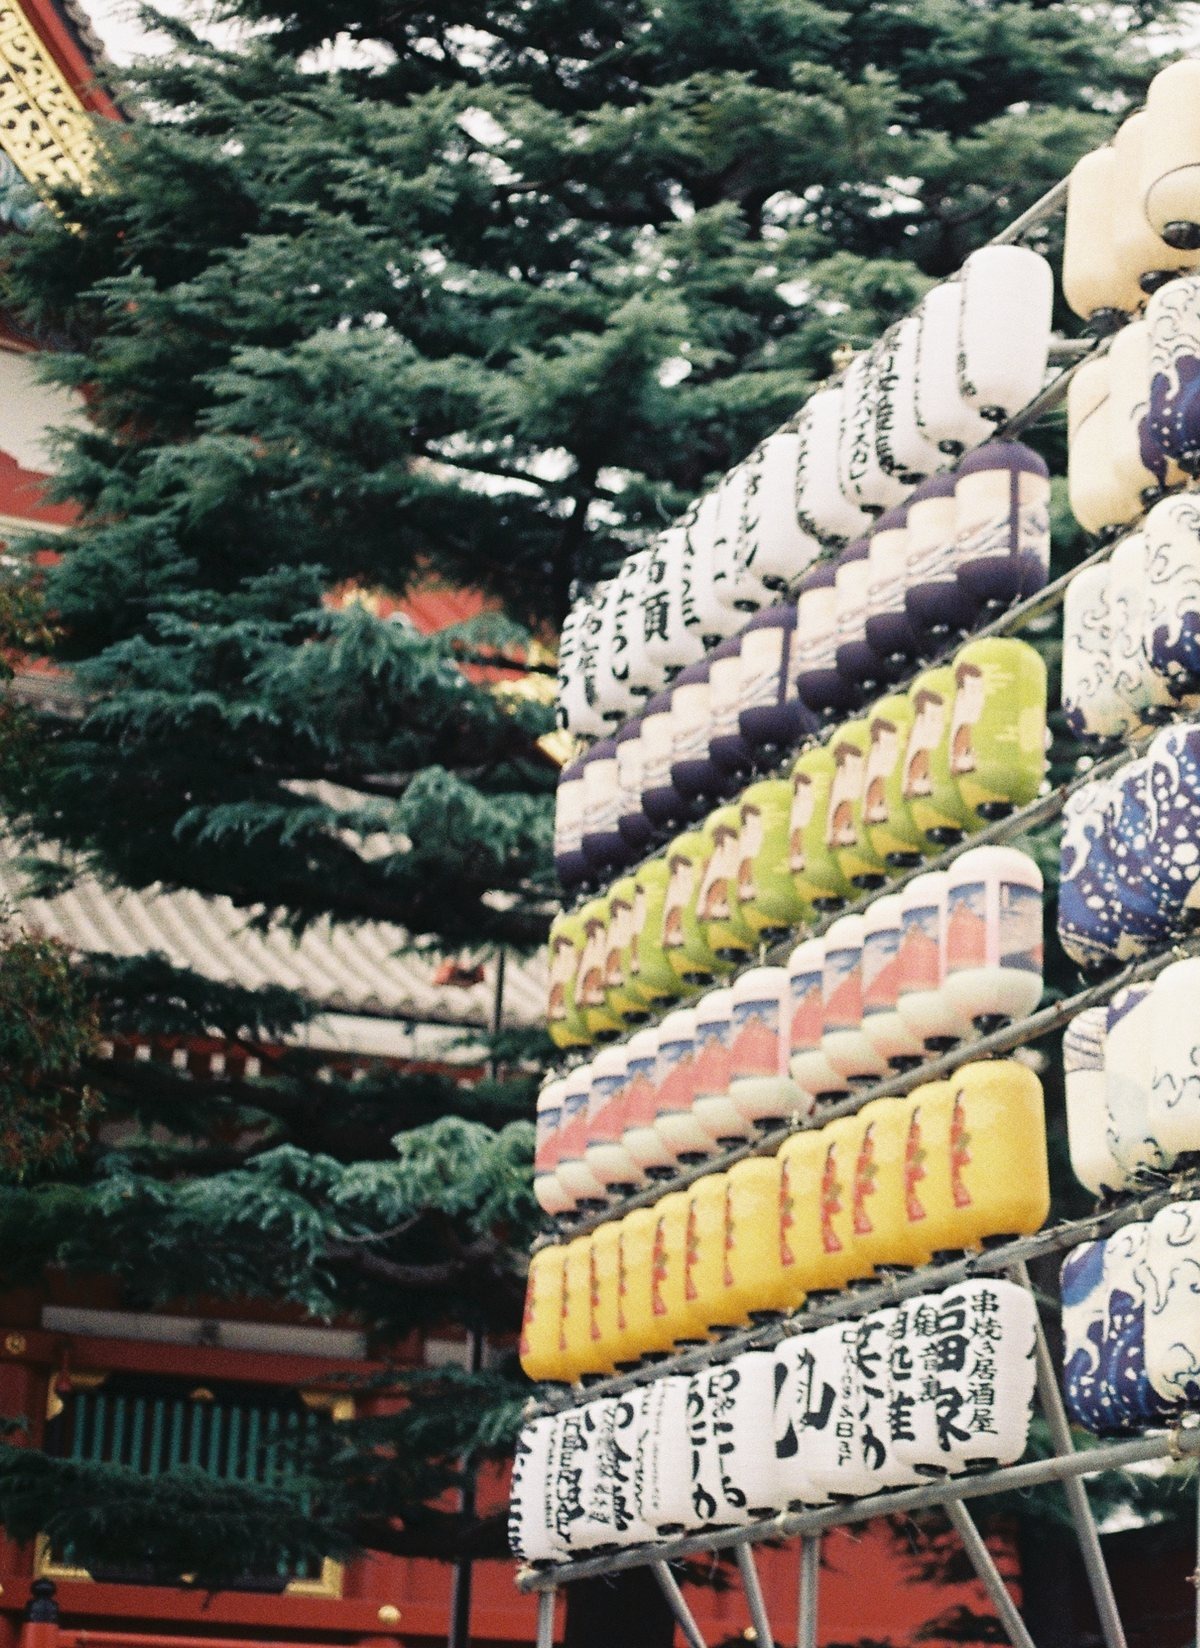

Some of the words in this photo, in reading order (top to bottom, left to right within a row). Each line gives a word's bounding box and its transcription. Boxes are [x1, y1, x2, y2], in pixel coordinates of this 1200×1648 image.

[967, 1289, 1002, 1435] 串焼き居酒屋
